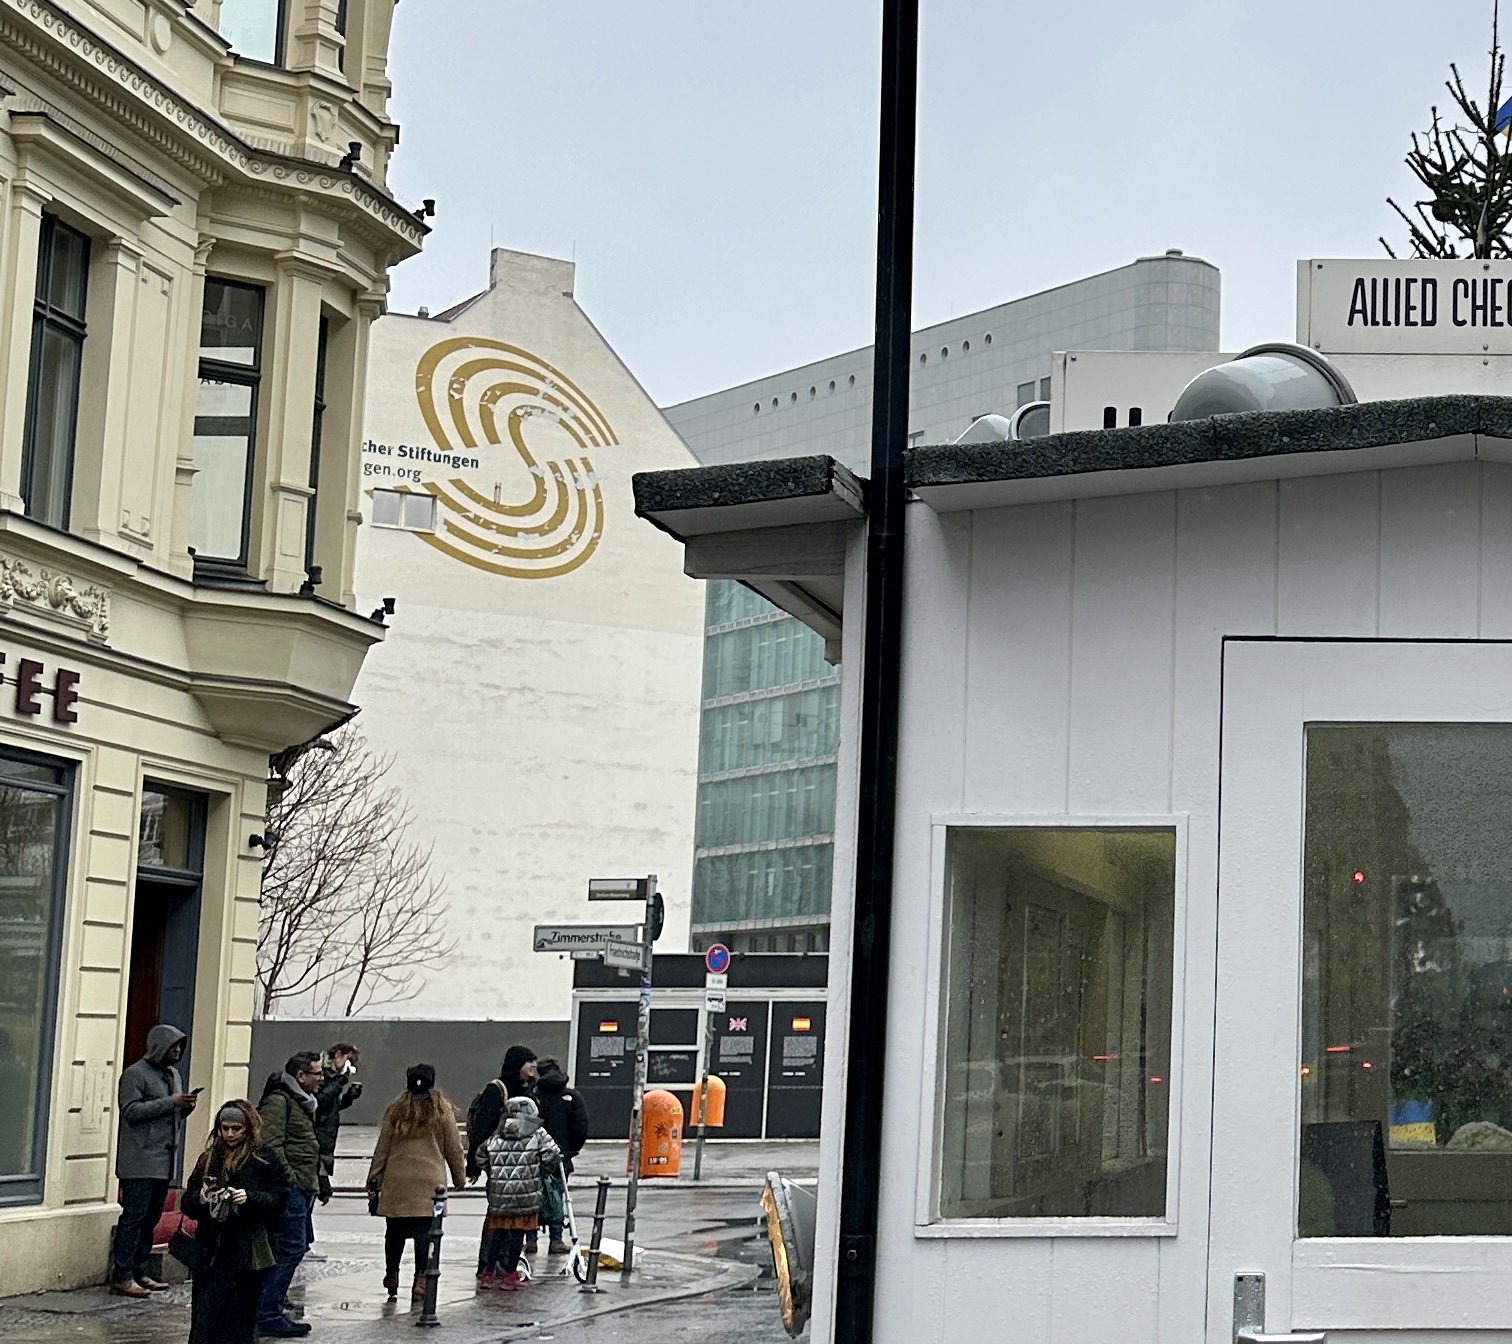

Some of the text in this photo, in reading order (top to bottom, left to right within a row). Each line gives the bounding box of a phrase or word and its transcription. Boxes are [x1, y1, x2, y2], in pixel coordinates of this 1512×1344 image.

[1347, 277, 1438, 327] ALLIED
[363, 462, 423, 483] gen.org
[397, 444, 480, 469] Stiftungen
[0, 652, 81, 723] EE
